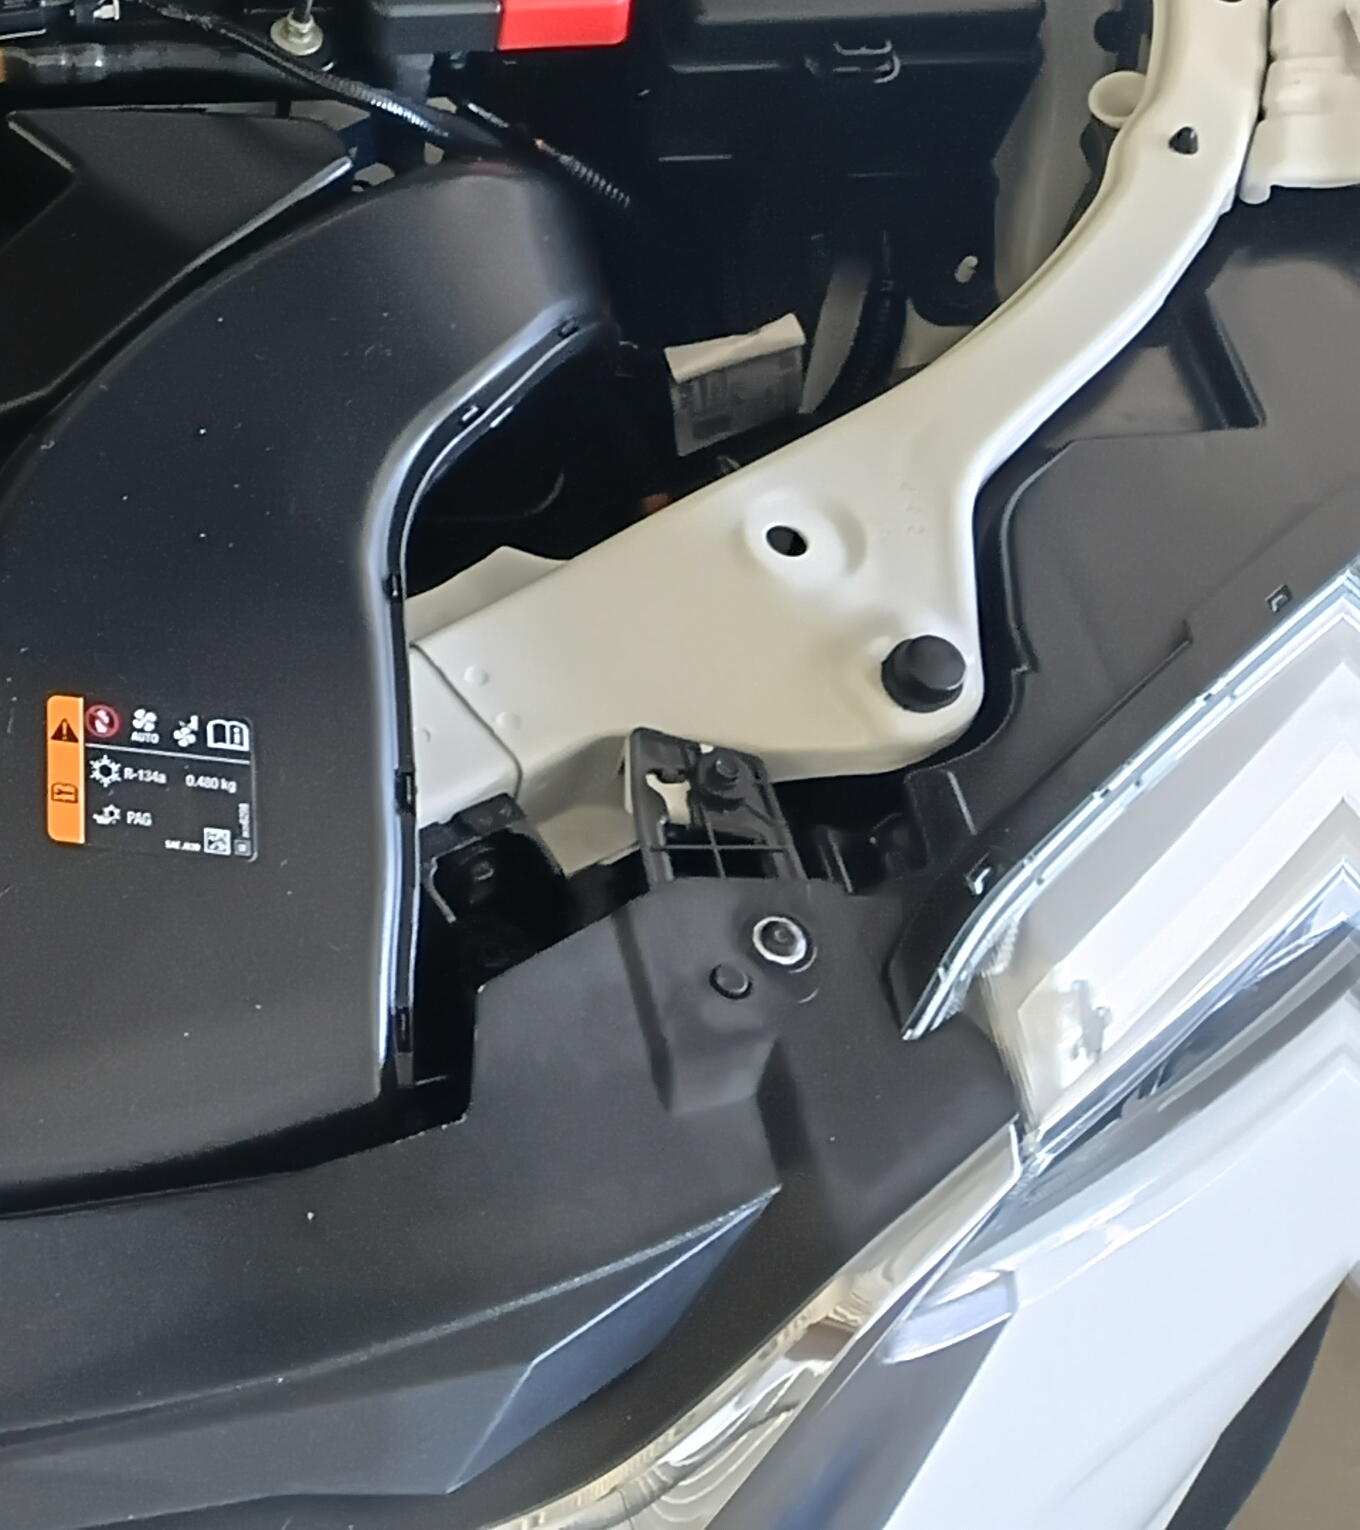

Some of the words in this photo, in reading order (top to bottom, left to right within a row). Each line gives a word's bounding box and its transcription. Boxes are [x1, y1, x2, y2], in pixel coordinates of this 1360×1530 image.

[131, 731, 159, 744] AUTO
[124, 766, 167, 784] R-134a
[220, 778, 237, 794] kg
[126, 810, 153, 826] PAG
